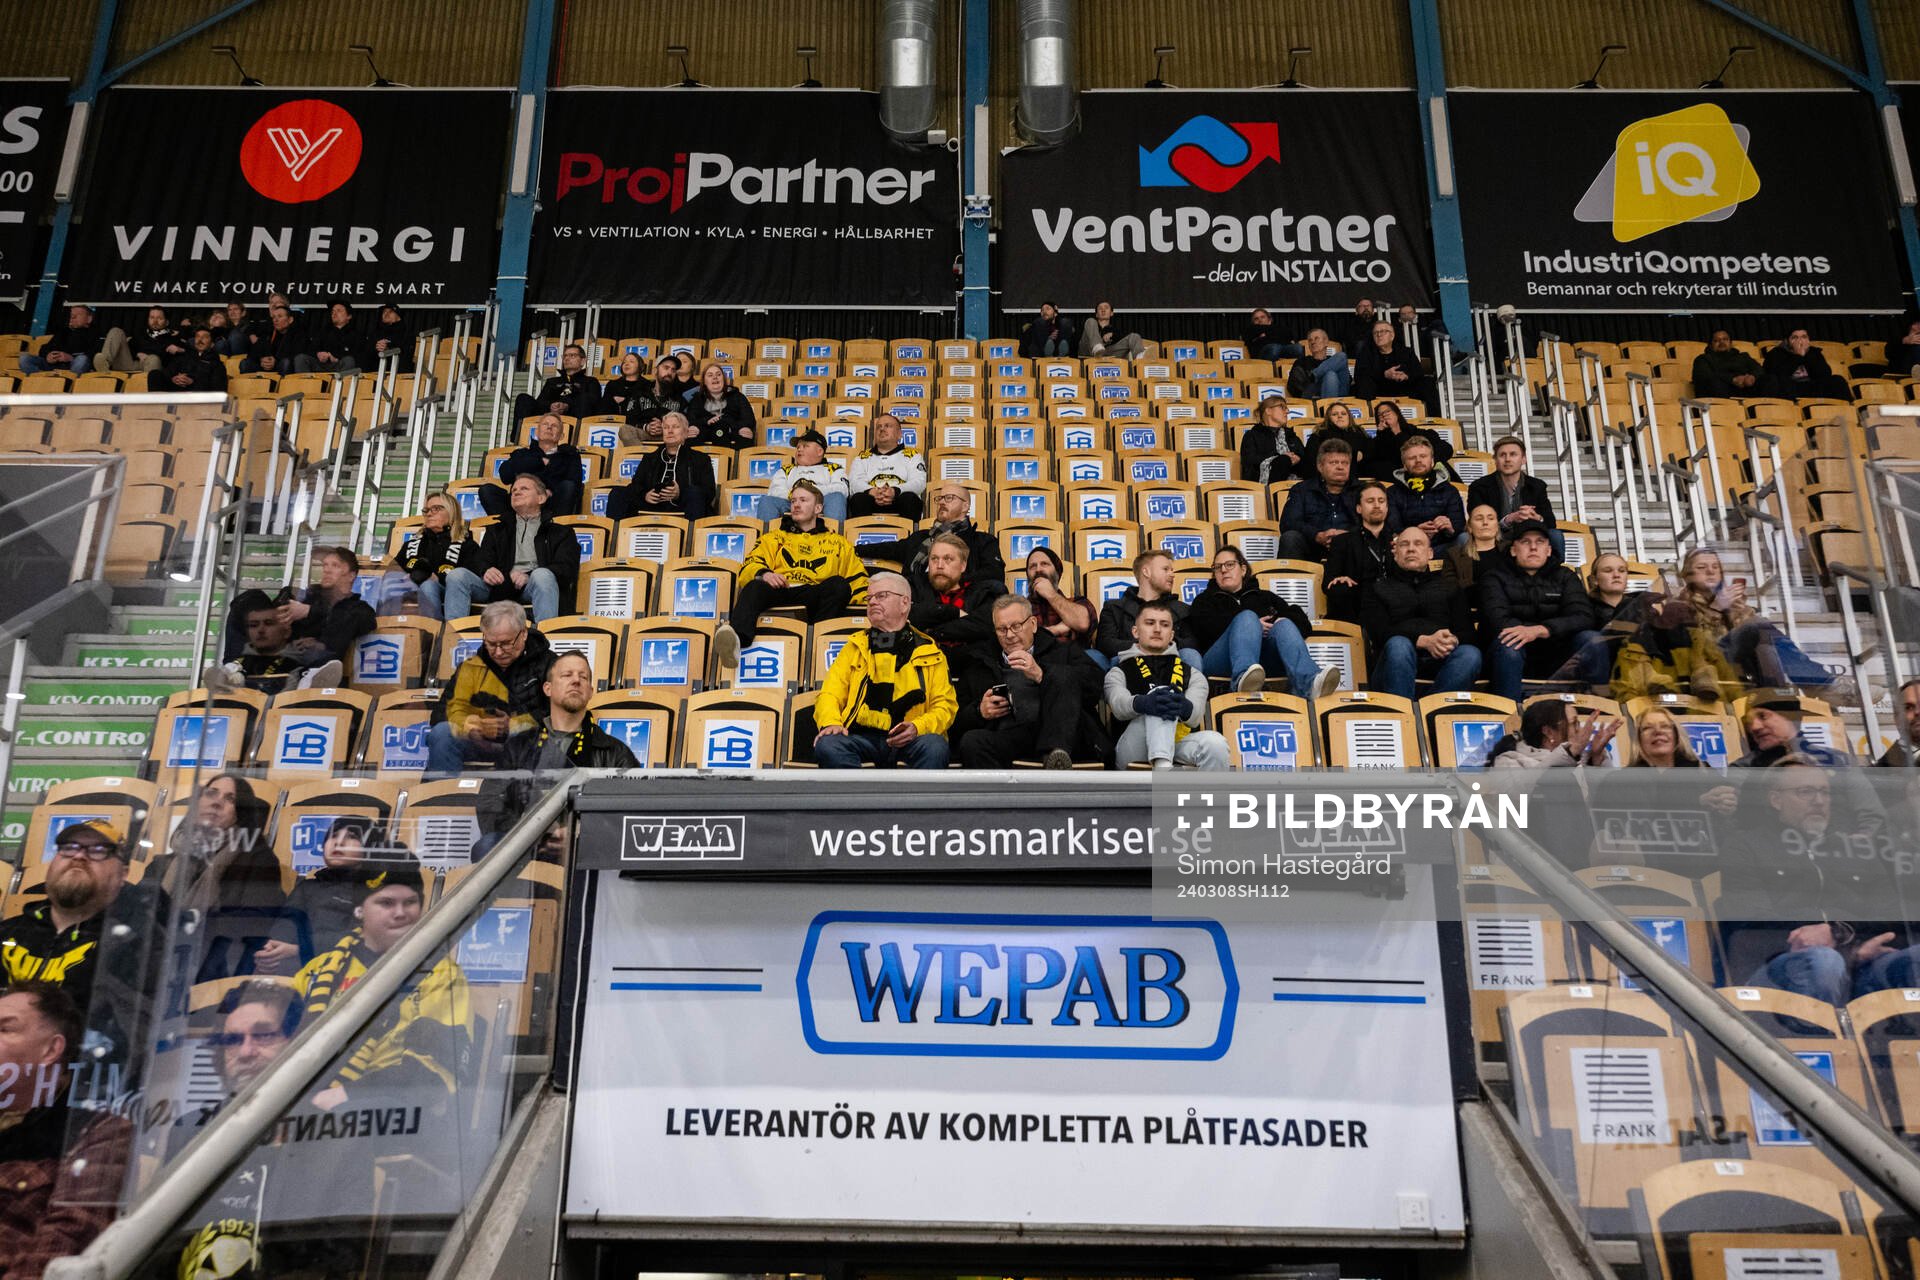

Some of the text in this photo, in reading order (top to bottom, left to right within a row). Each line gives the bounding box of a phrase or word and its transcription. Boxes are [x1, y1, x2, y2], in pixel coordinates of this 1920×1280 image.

[1635, 141, 1719, 197] iQ
[556, 152, 935, 214] ProjPartner
[553, 225, 934, 240] VS VENTILATION KYLA ENERGI HÅLLBARHET
[1031, 206, 1396, 254] VentPartner
[113, 225, 466, 263] VINNERGI
[1235, 270, 1258, 283] av
[1261, 260, 1392, 283] INSTALCO
[1523, 249, 1831, 279] IndustriQompetens
[115, 281, 446, 295] WE MAKE YOUR FUTURE SMART
[1527, 281, 1838, 299] Bemannar och rekryterar till industrin
[680, 580, 711, 601] LF
[648, 641, 682, 666] LF
[740, 656, 779, 679] HB
[282, 733, 328, 758] HB
[707, 738, 753, 762] HB
[1240, 732, 1292, 755] HJT
[1357, 763, 1397, 772] FRANK
[632, 824, 735, 852] WEMA
[810, 817, 1213, 856] westerasmarkiser.se
[840, 941, 1190, 1029] WEPAB
[1480, 973, 1535, 986] FRANK
[665, 1102, 1369, 1148] LEVERANTÖR AV KOMPLETTA PLÅTFASADER
[1592, 1124, 1657, 1138] FRANK
